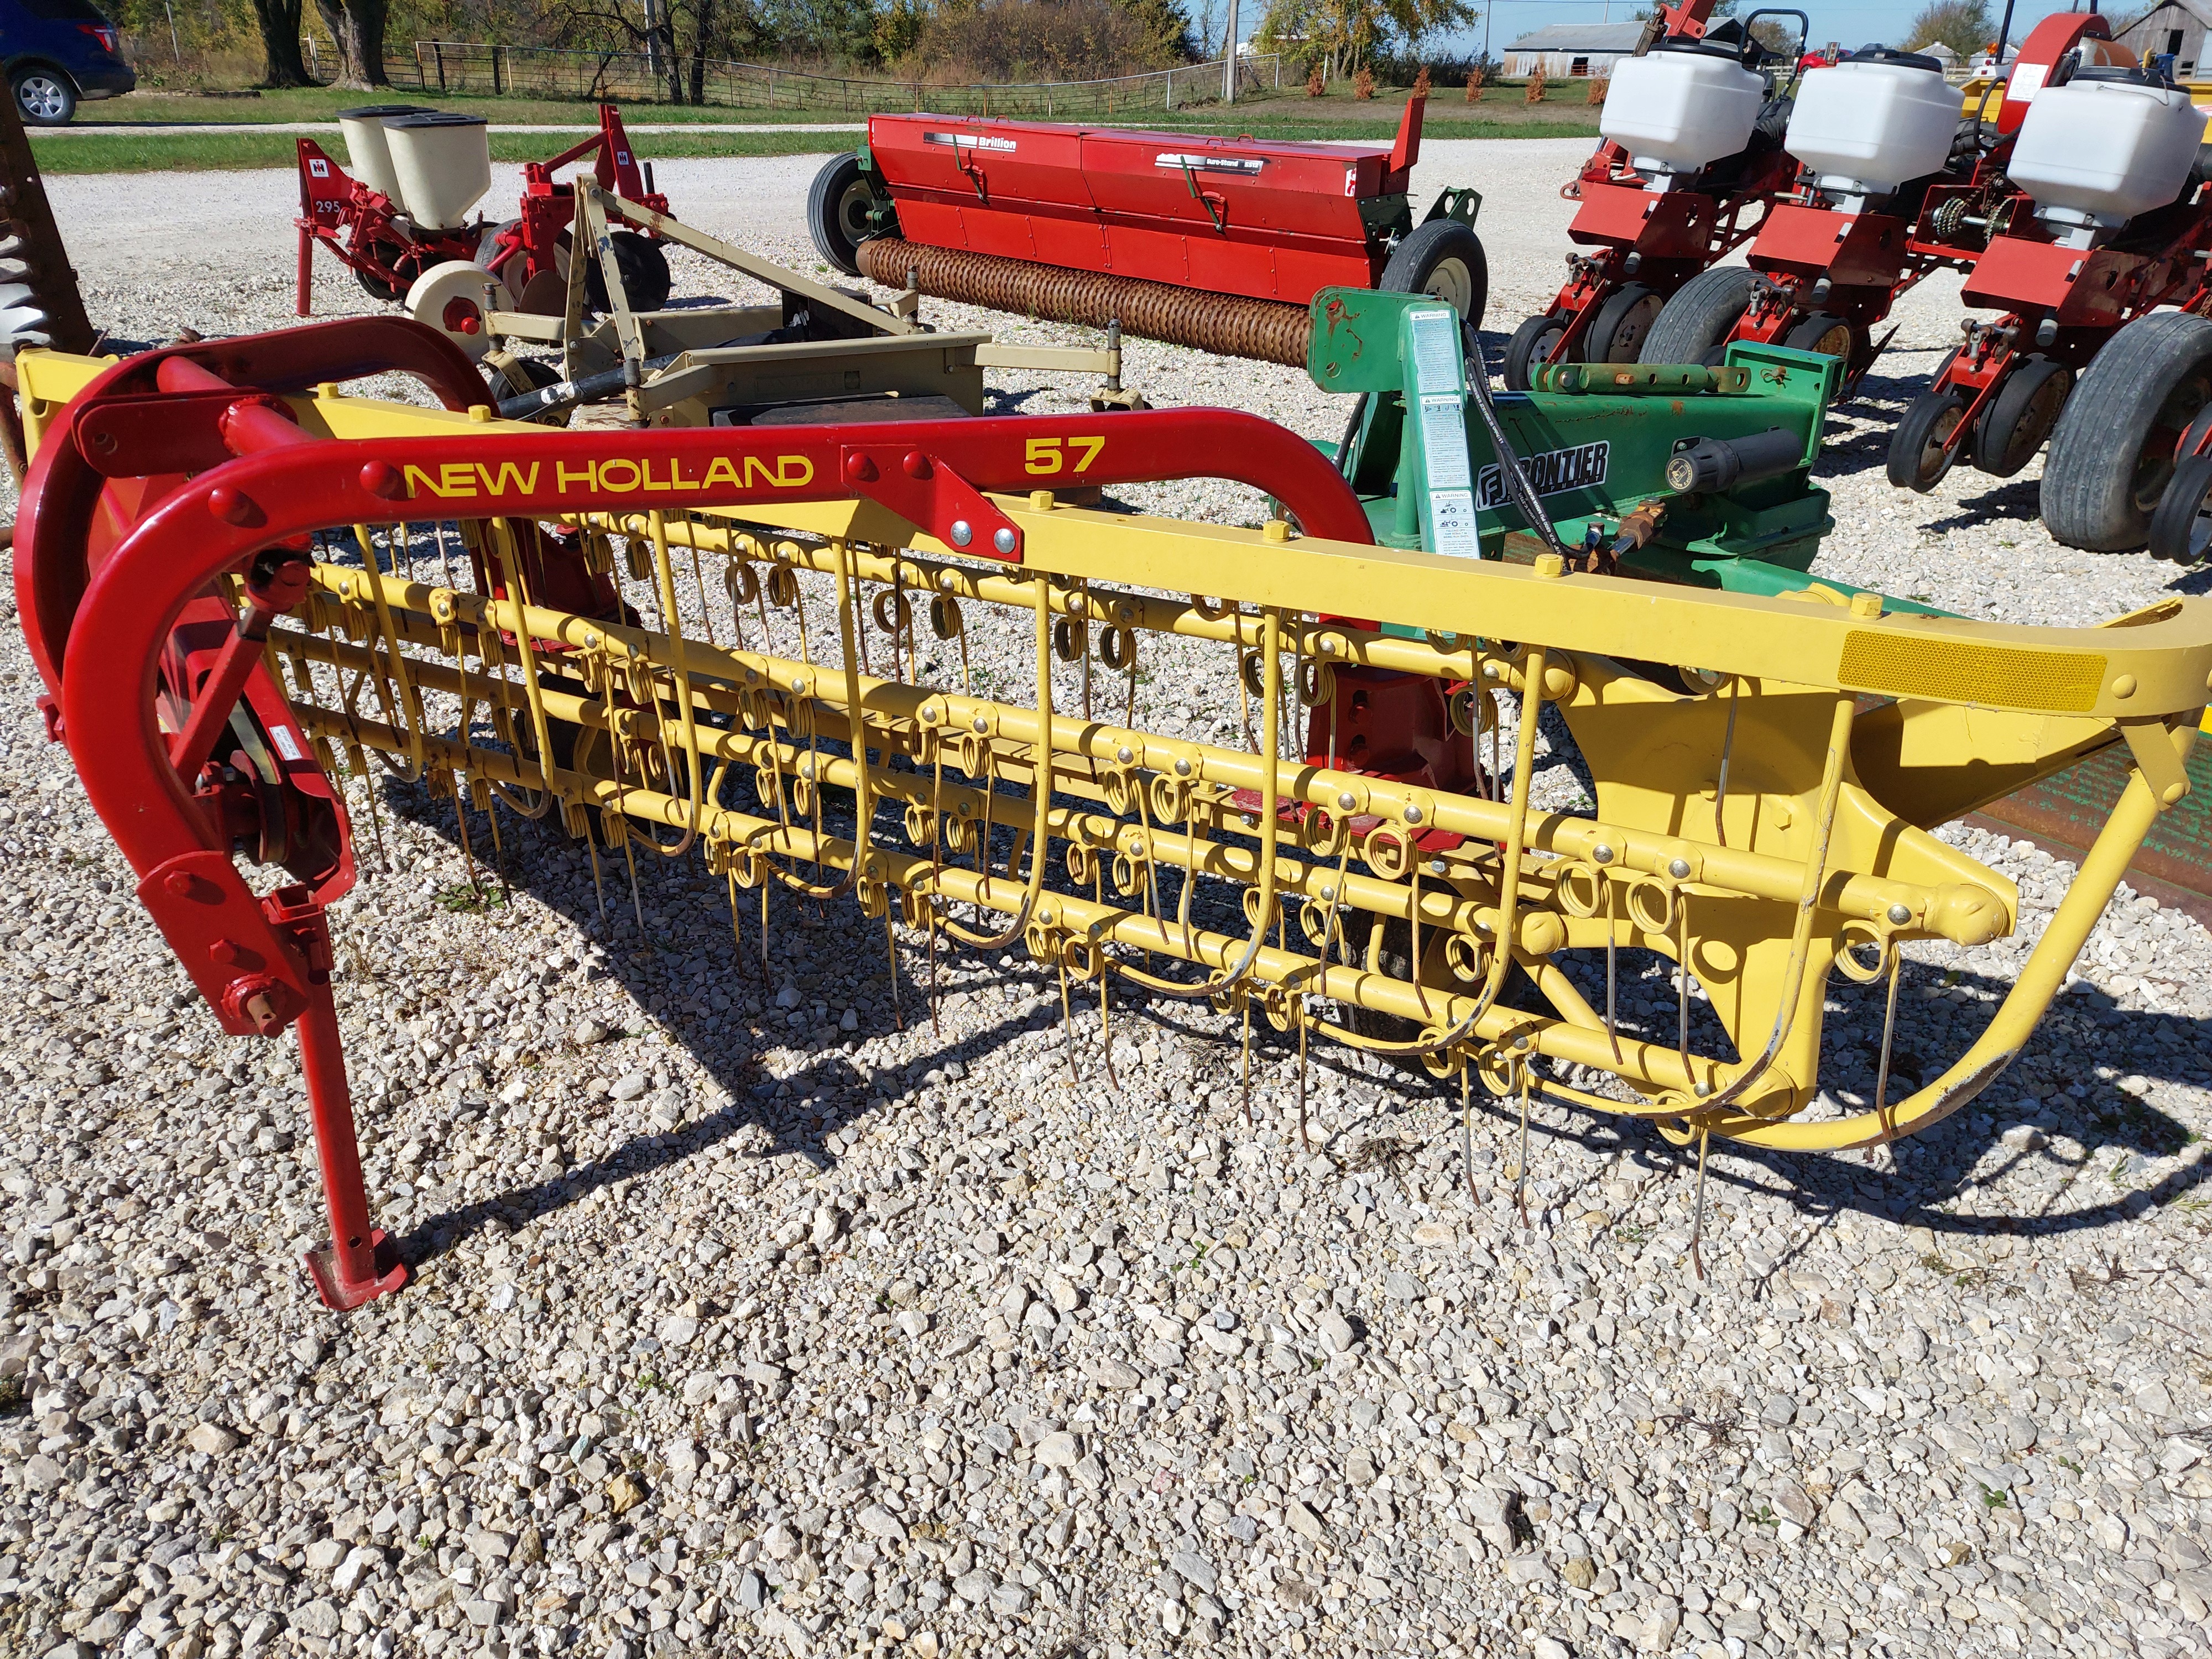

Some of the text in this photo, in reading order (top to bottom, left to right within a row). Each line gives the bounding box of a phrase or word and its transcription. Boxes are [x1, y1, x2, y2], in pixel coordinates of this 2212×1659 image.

[979, 137, 1016, 149] Brillion
[316, 201, 340, 213] 295
[1025, 436, 1105, 474] 57
[403, 455, 813, 498] NEW HOLLAND
